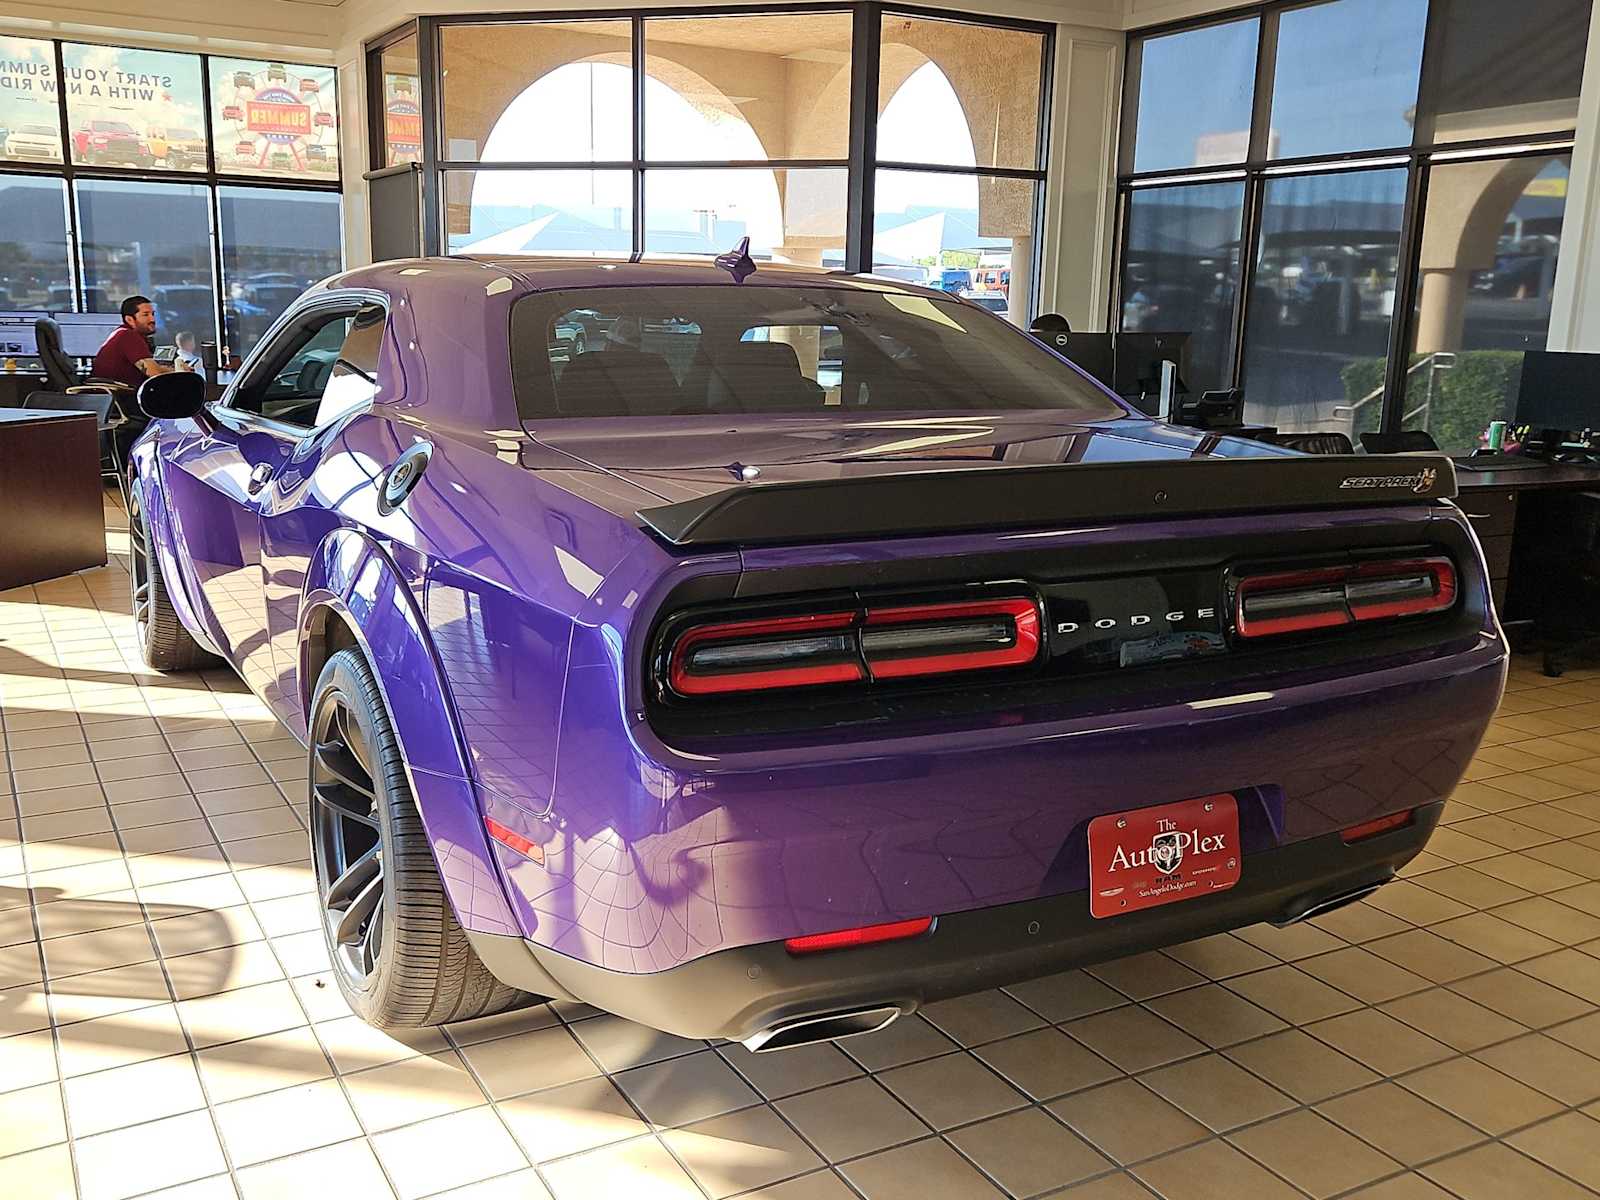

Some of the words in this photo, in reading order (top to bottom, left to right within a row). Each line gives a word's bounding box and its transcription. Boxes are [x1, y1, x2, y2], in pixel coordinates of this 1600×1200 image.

[1057, 607, 1215, 634] DODGE
[1156, 818, 1177, 833] The
[1108, 828, 1226, 873] AutoPlex
